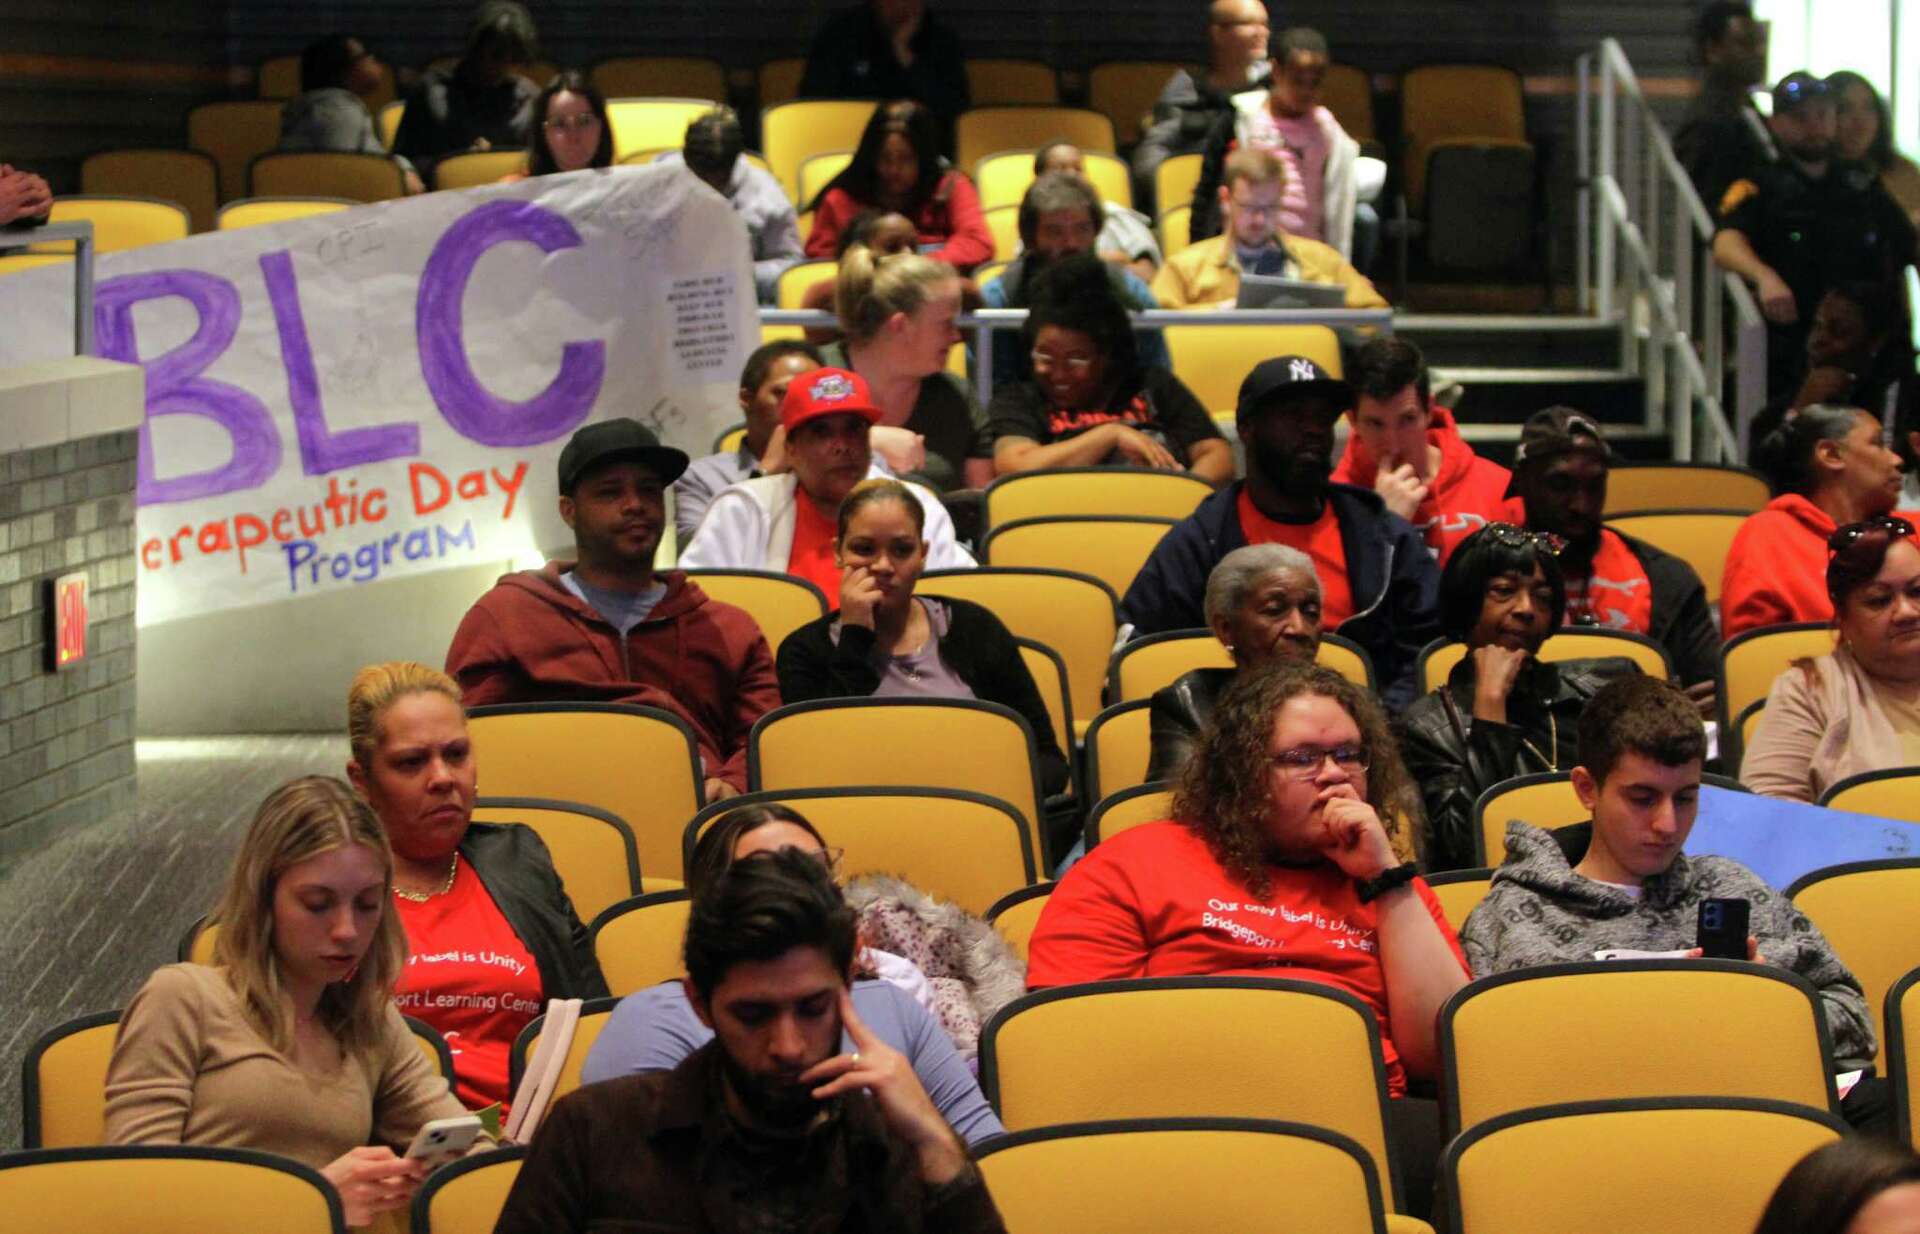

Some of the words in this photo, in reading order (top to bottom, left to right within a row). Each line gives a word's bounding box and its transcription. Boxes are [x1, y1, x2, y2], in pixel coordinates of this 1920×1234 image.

[94, 199, 606, 505] BLC
[142, 477, 388, 574] erapeutic
[408, 462, 530, 519] Day
[1280, 905, 1313, 923] label
[1316, 914, 1326, 929] is
[463, 951, 476, 962] is
[480, 951, 527, 976] Unity
[425, 989, 497, 1013] Learning
